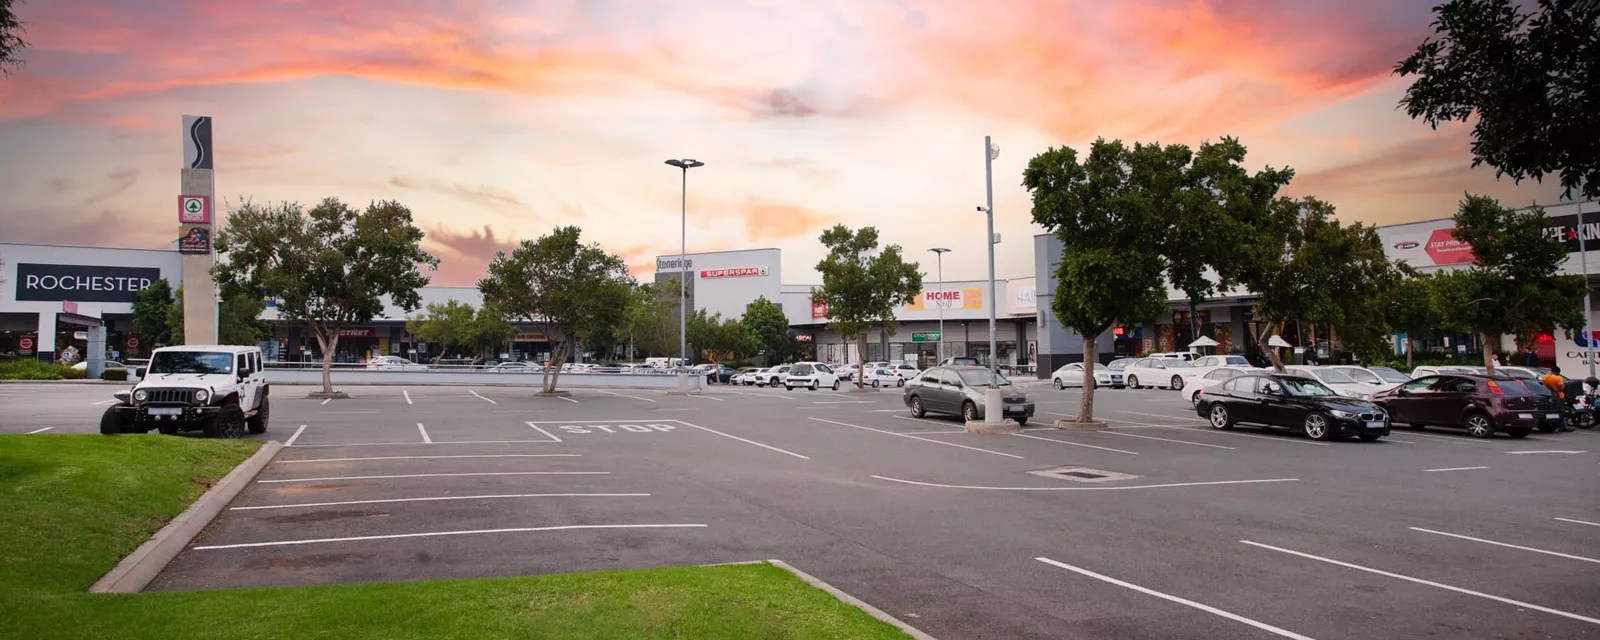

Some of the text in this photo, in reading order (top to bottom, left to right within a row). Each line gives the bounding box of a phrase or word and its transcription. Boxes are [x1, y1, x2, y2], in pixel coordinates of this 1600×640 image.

[1541, 226, 1566, 242] APE
[706, 268, 758, 277] SUPERSPAR
[26, 275, 151, 292] ROCHESTER
[926, 291, 960, 300] HOME
[559, 424, 677, 433] STOP
